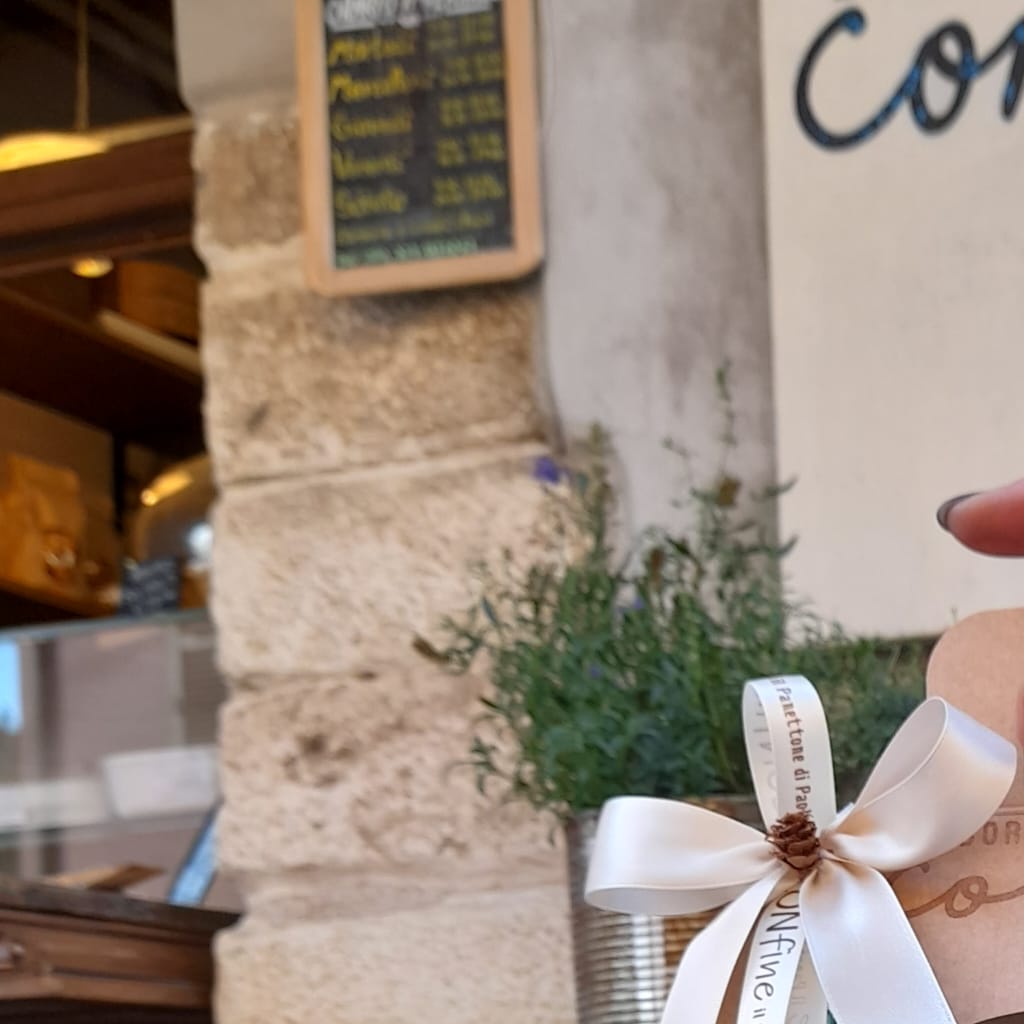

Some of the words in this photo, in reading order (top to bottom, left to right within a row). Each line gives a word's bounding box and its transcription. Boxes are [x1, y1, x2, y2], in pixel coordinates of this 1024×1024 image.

[776, 687, 805, 763] Panettone
[794, 768, 810, 781] di
[796, 786, 814, 818] Pao
